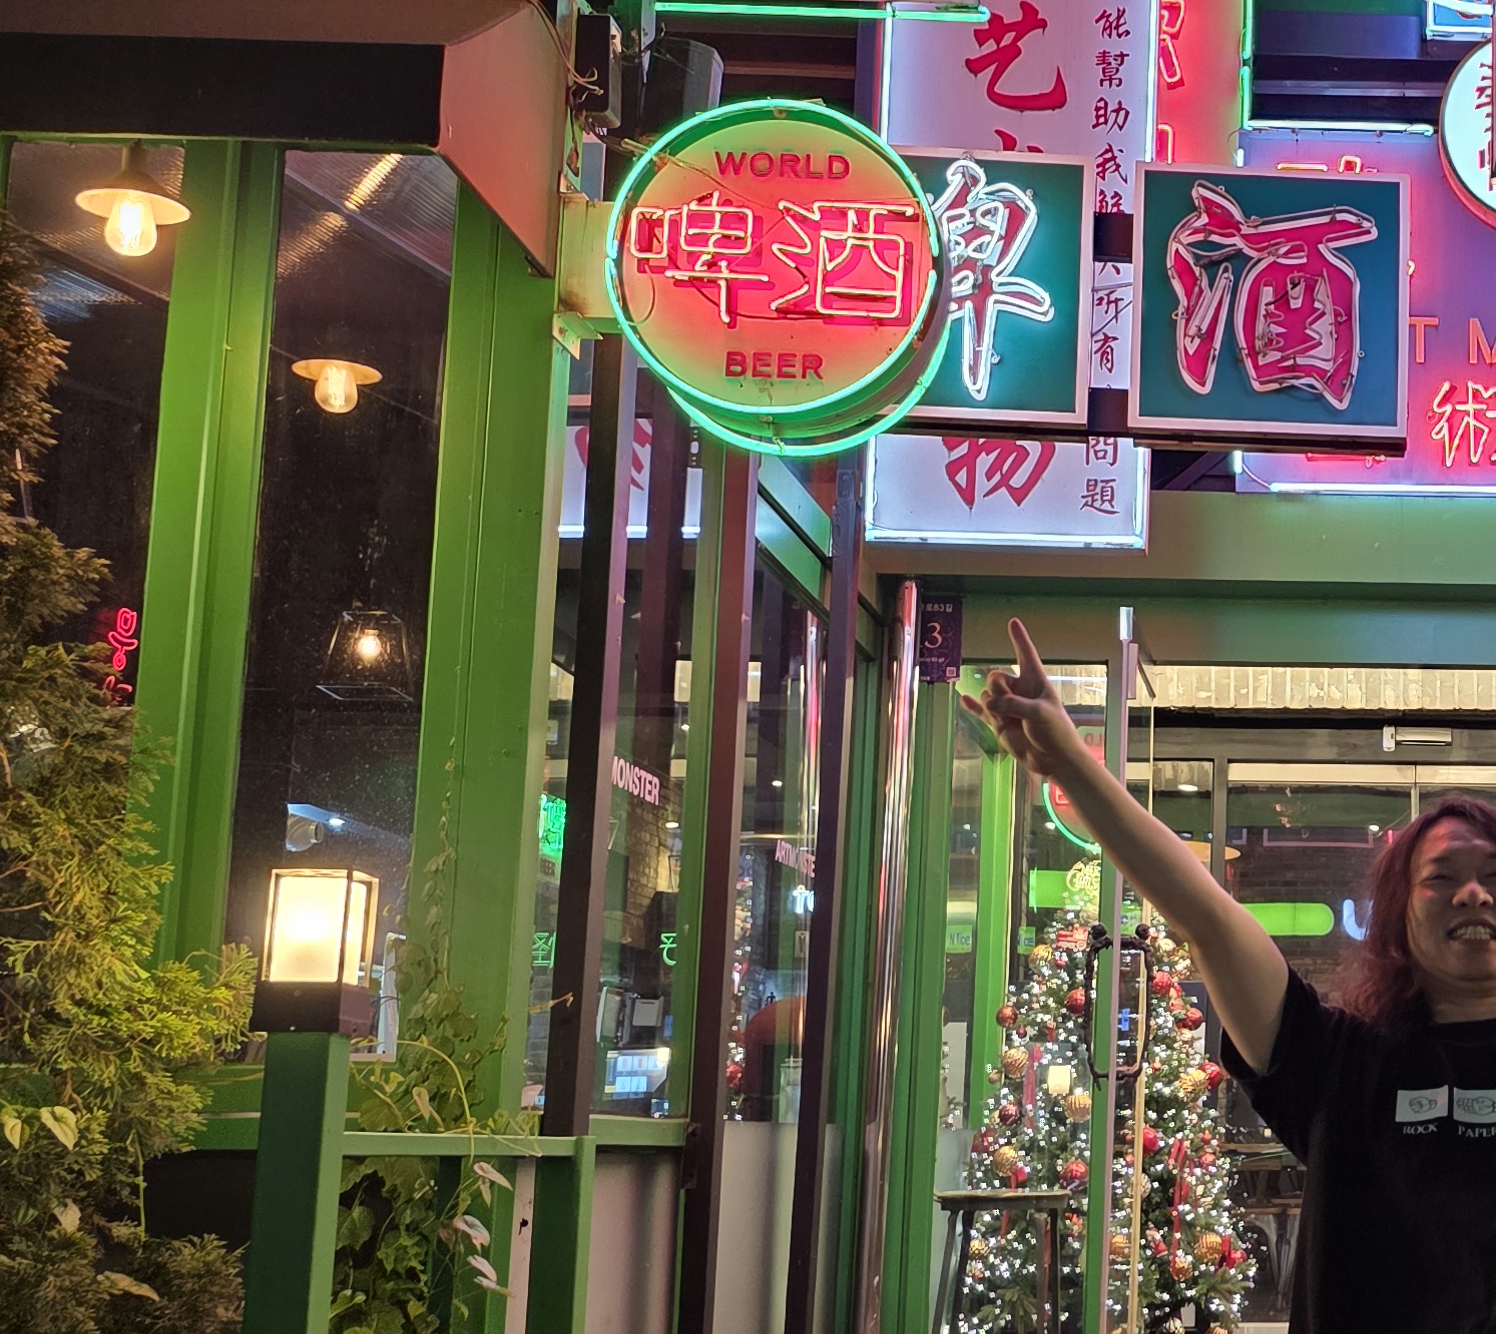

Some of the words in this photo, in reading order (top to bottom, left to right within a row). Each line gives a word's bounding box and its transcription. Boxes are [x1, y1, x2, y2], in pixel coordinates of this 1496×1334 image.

[714, 150, 850, 180] WORLD
[630, 190, 915, 325] 啤酒
[724, 351, 824, 380] BEER
[923, 622, 943, 649] 3
[1403, 1123, 1437, 1135] ROCK
